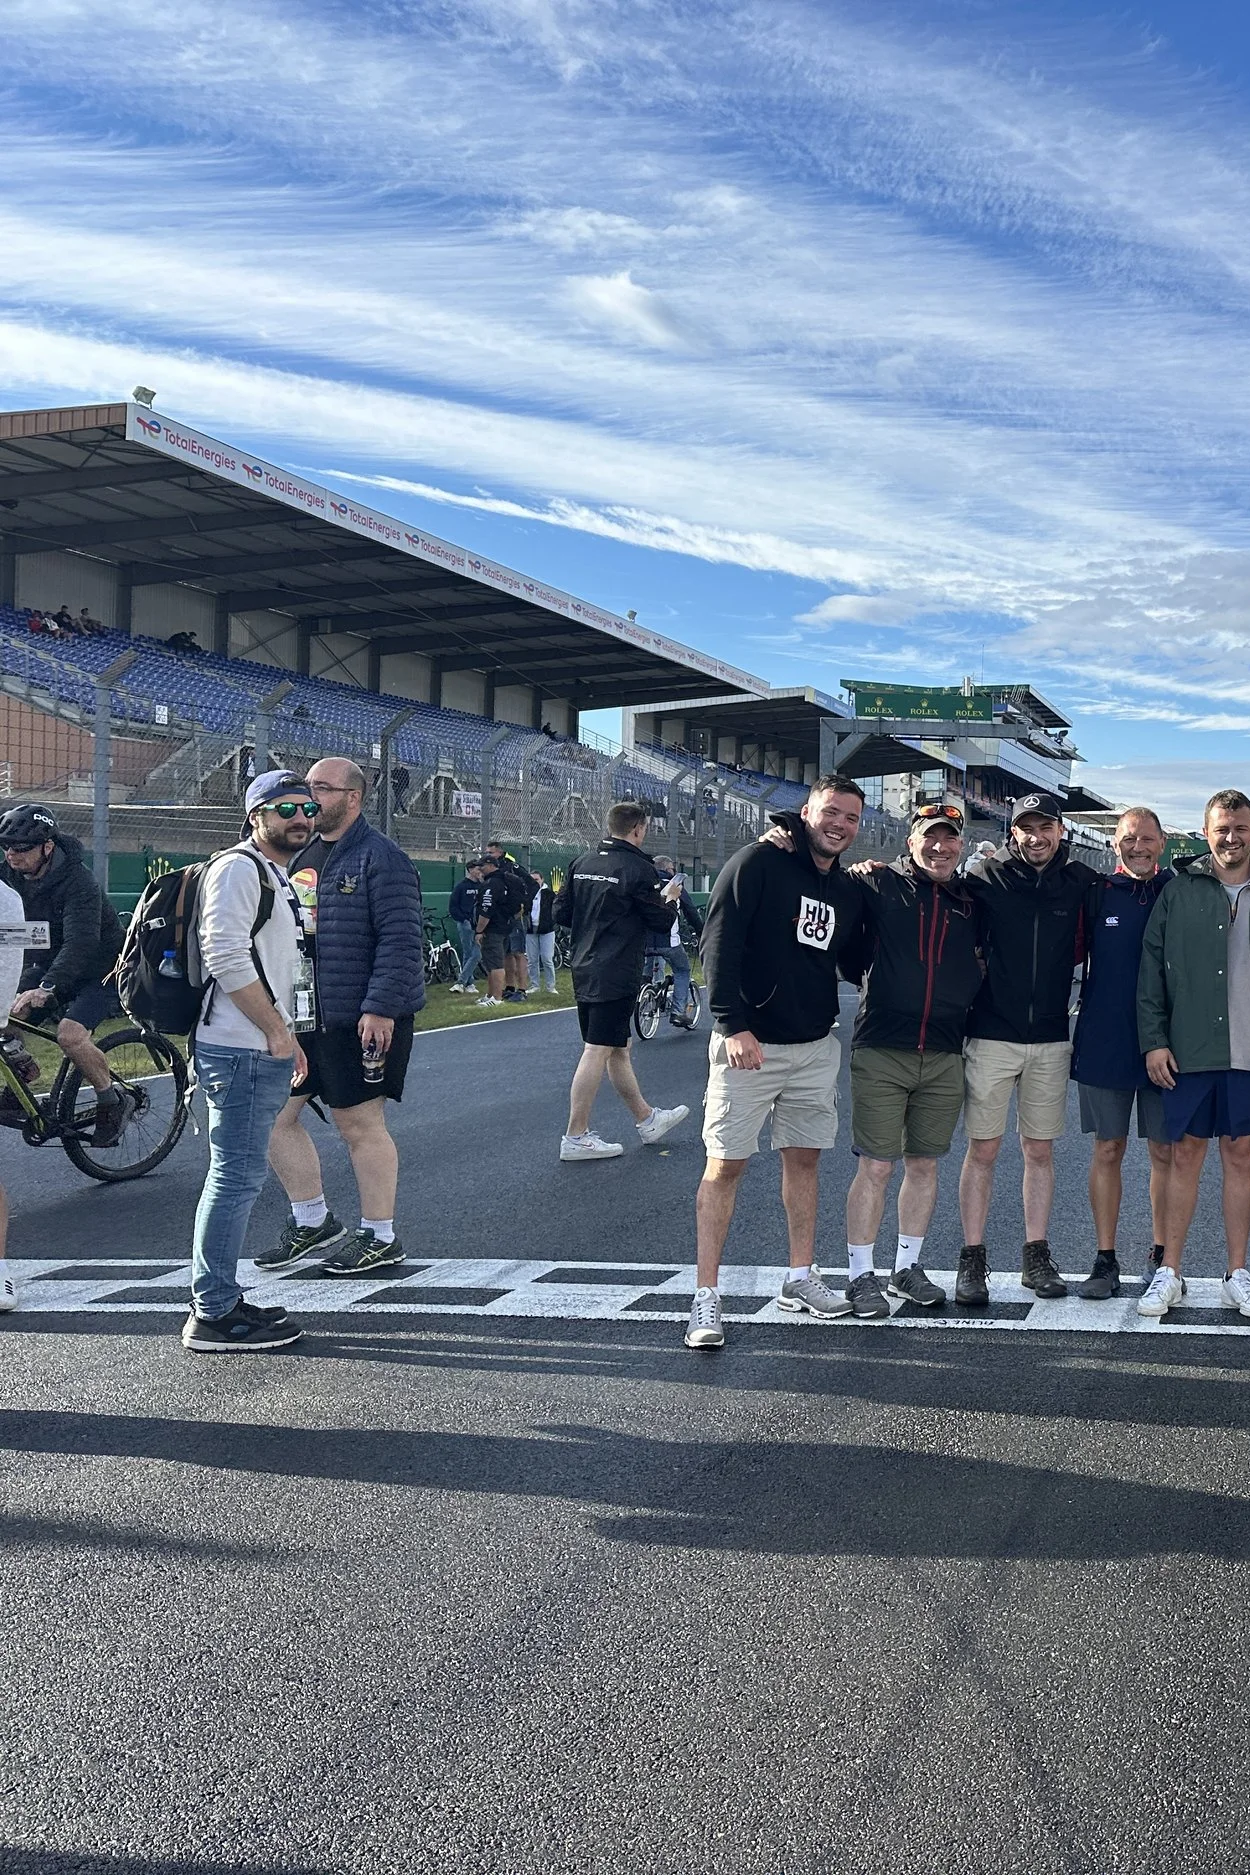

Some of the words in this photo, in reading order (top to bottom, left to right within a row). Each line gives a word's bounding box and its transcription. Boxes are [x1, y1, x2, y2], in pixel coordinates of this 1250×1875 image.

[163, 427, 236, 471] TotalEnergies
[264, 471, 325, 510] TotalEnergies
[349, 508, 401, 541] TotalEnergies
[420, 538, 465, 568] TotalEnergies
[864, 706, 893, 714] ROLEX
[910, 707, 939, 716] ROLEX
[955, 709, 984, 718] ROLEX
[573, 873, 620, 884] PORSCHE
[802, 921, 828, 942] GO
